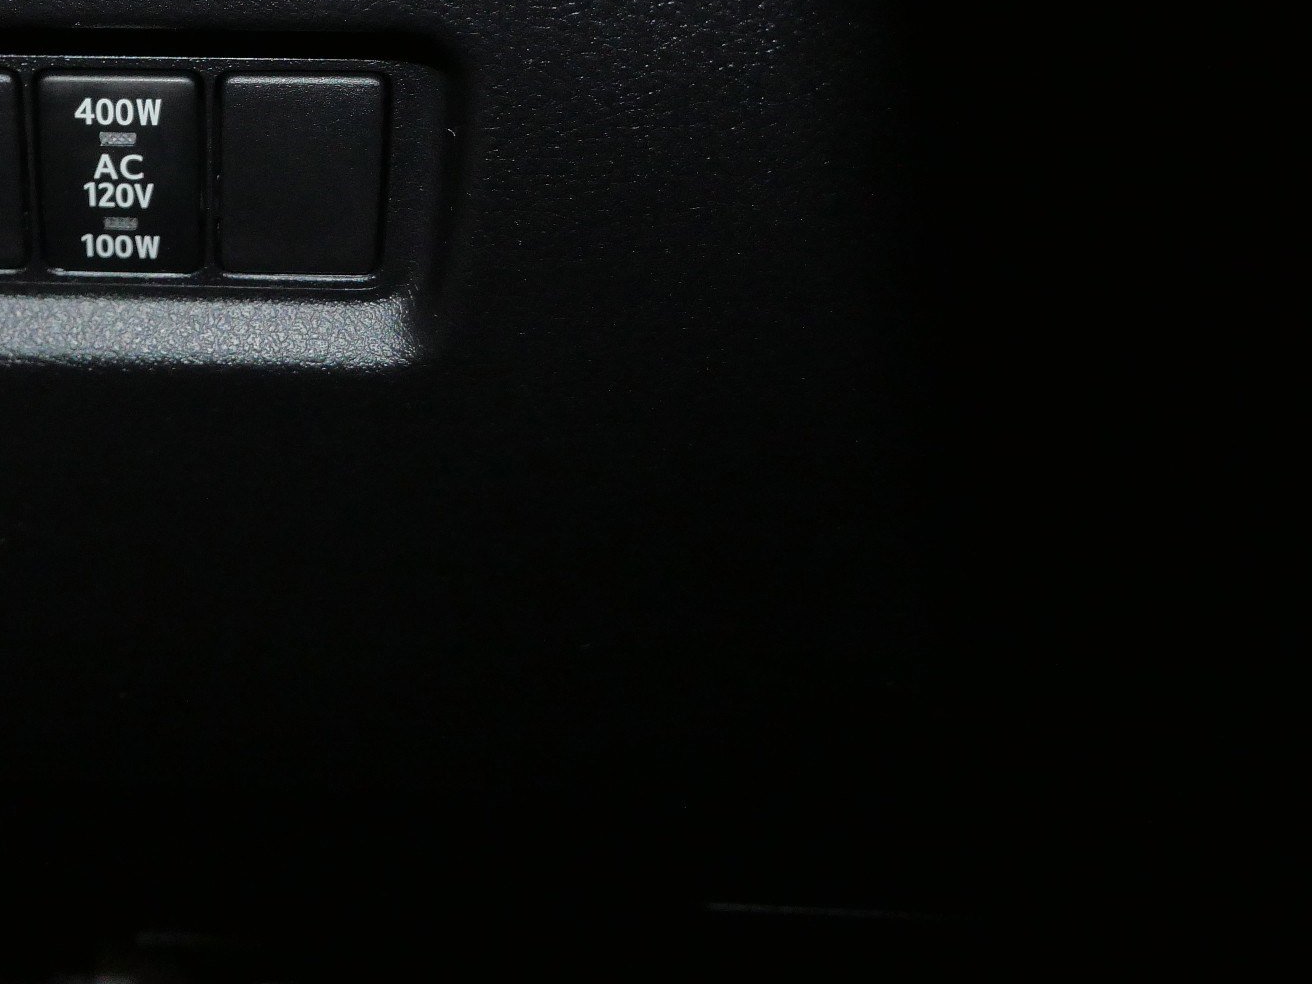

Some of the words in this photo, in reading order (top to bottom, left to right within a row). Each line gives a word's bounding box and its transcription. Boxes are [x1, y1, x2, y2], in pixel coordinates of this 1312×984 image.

[74, 97, 162, 126] 400W
[93, 153, 145, 180] AC
[83, 181, 155, 209] 120V
[80, 233, 161, 259] 100W
